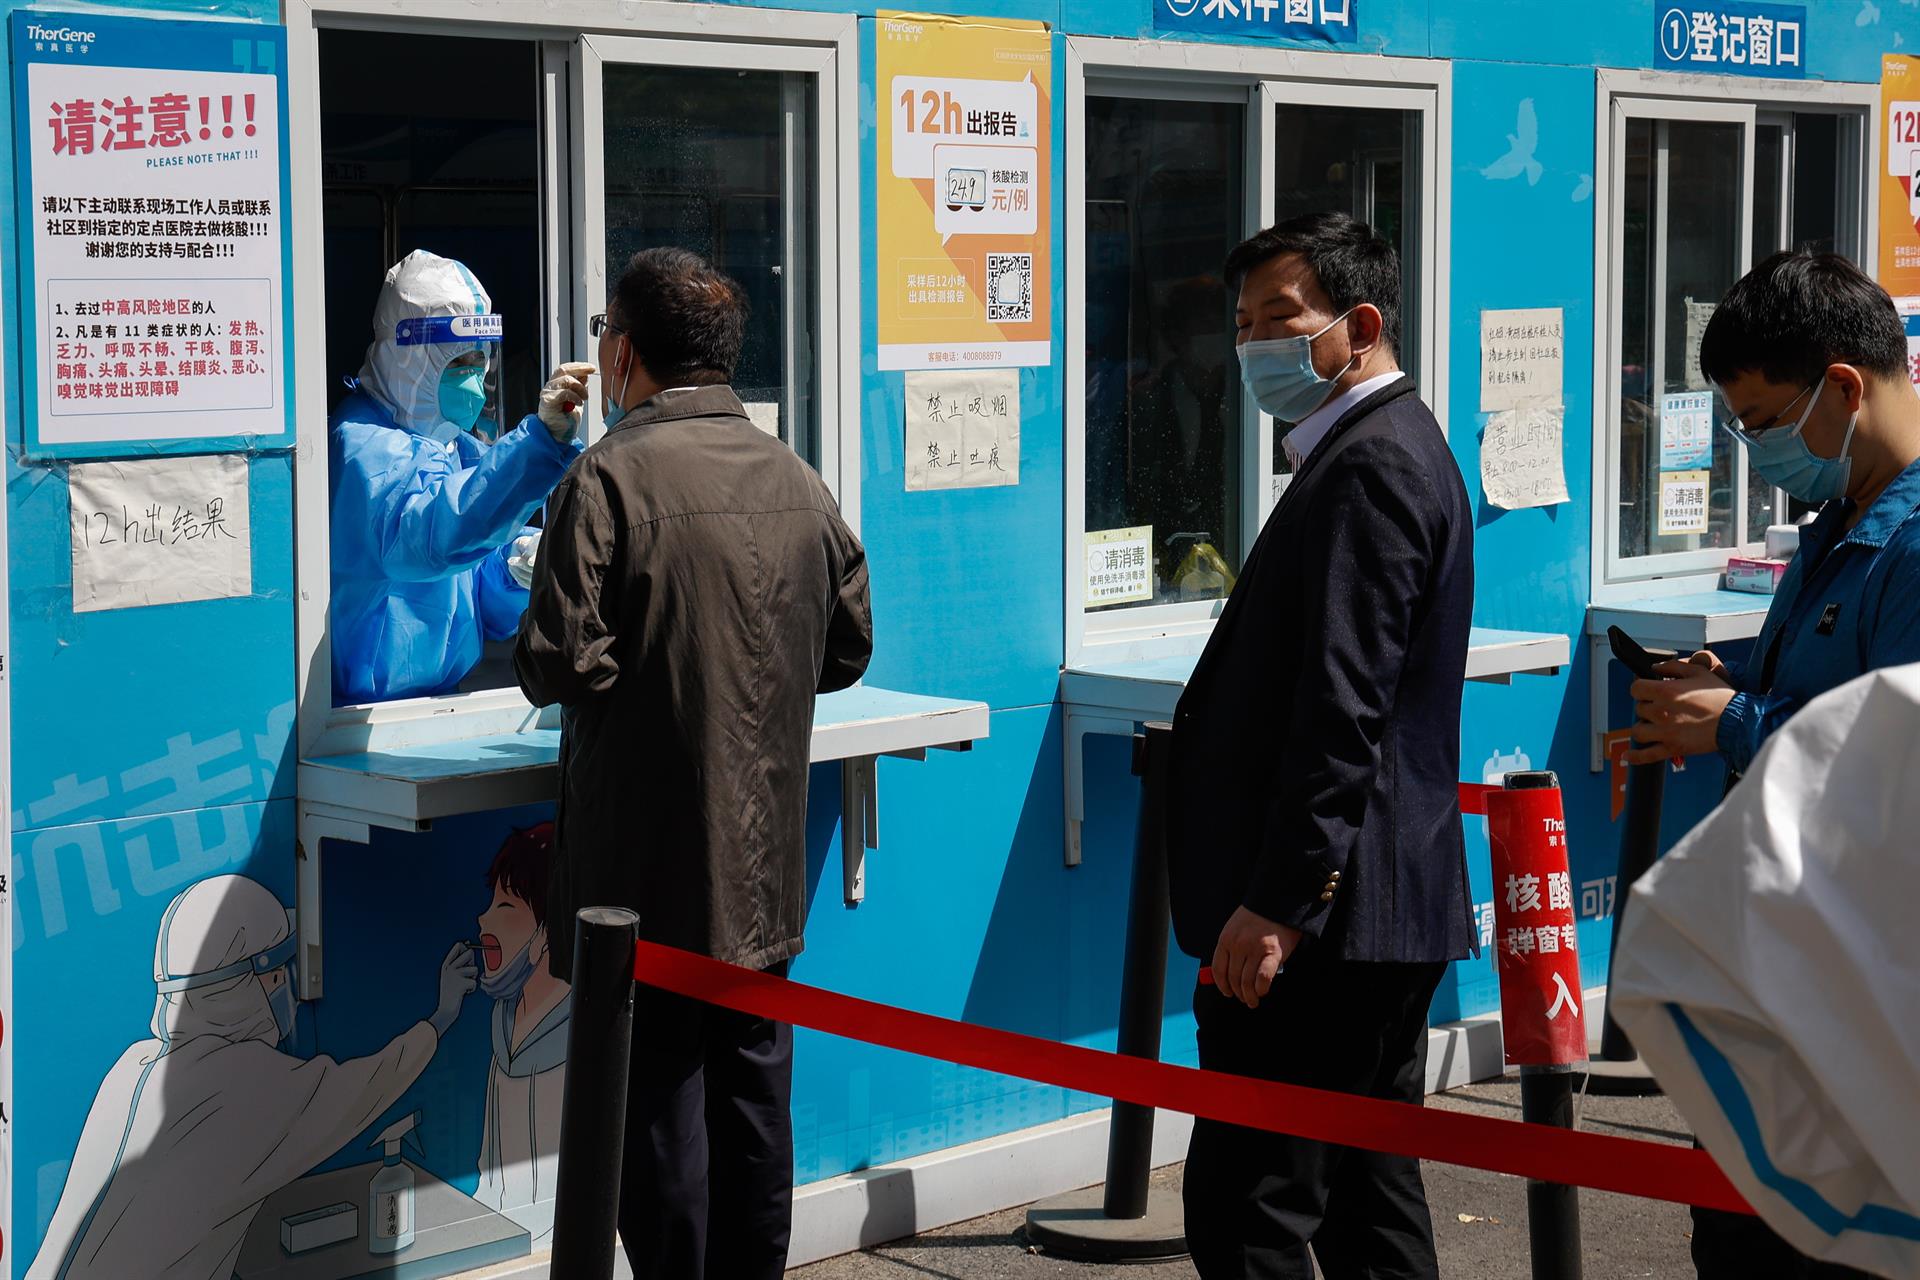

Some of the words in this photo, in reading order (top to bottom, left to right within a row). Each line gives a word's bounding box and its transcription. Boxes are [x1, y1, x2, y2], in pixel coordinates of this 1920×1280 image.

[26, 25, 96, 43] ThorGene
[884, 22, 923, 34] ThorGene
[48, 92, 257, 156] 请注意!!!
[146, 156, 184, 168] PLEASE
[187, 153, 213, 164] NOTE
[216, 151, 241, 161] THAT
[992, 170, 1028, 184] 核酸检测
[43, 196, 272, 216] 请以下主动联系现场工作人员或联系
[992, 188, 1029, 213] 元/例
[47, 219, 269, 237] 社区到指定的定点医院去做核酸!!!
[86, 242, 235, 259] 谢谢您的支持与配合!!!
[907, 274, 966, 287] 采样后12小时
[908, 289, 966, 304] 出具检测报告
[55, 299, 216, 316] 1、去过中高风险地区的人
[56, 340, 266, 360] 乏力、呼吸不畅、干咳、腹泻、
[57, 360, 266, 380] 胸痛、头痛、头晕、结膜炎、恶心、
[57, 380, 180, 399] 嗅觉味觉出现障碍
[927, 392, 1008, 423] 禁止吸烟
[927, 441, 1006, 471] 禁止吐痰
[1675, 488, 1703, 505] 请消毒
[84, 497, 237, 548] 12h出结果
[1104, 546, 1145, 570] 请消毒
[1090, 570, 1145, 586] 使用免洗手消毒液
[1545, 972, 1579, 1020] 入
